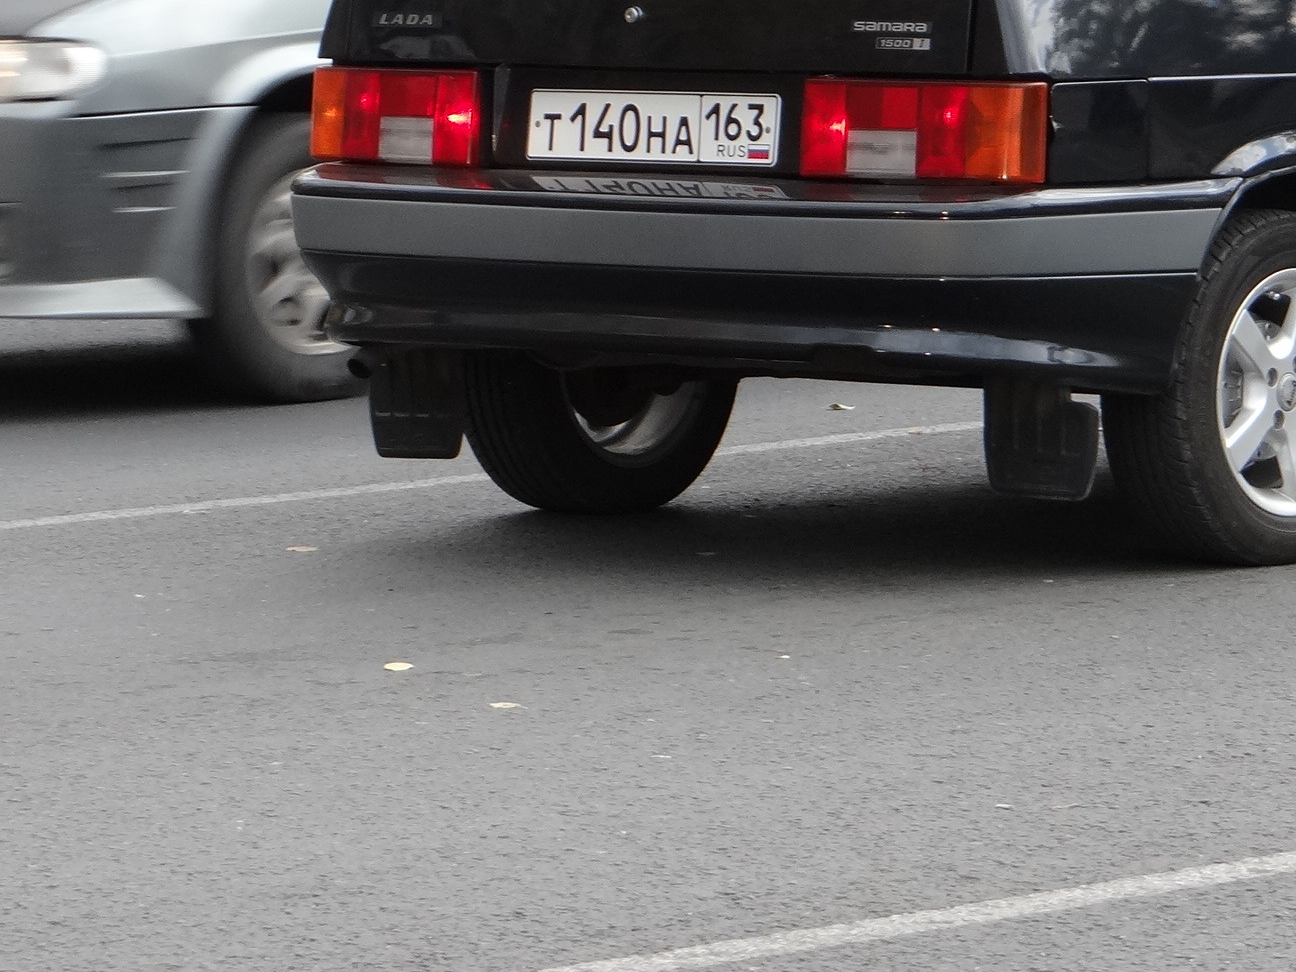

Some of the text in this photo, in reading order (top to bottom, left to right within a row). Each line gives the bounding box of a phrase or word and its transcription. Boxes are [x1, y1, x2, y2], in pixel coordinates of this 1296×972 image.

[379, 13, 434, 26] LADA
[879, 38, 913, 48] 1500
[543, 102, 766, 155] Т140НА 163
[716, 144, 747, 158] RUS
